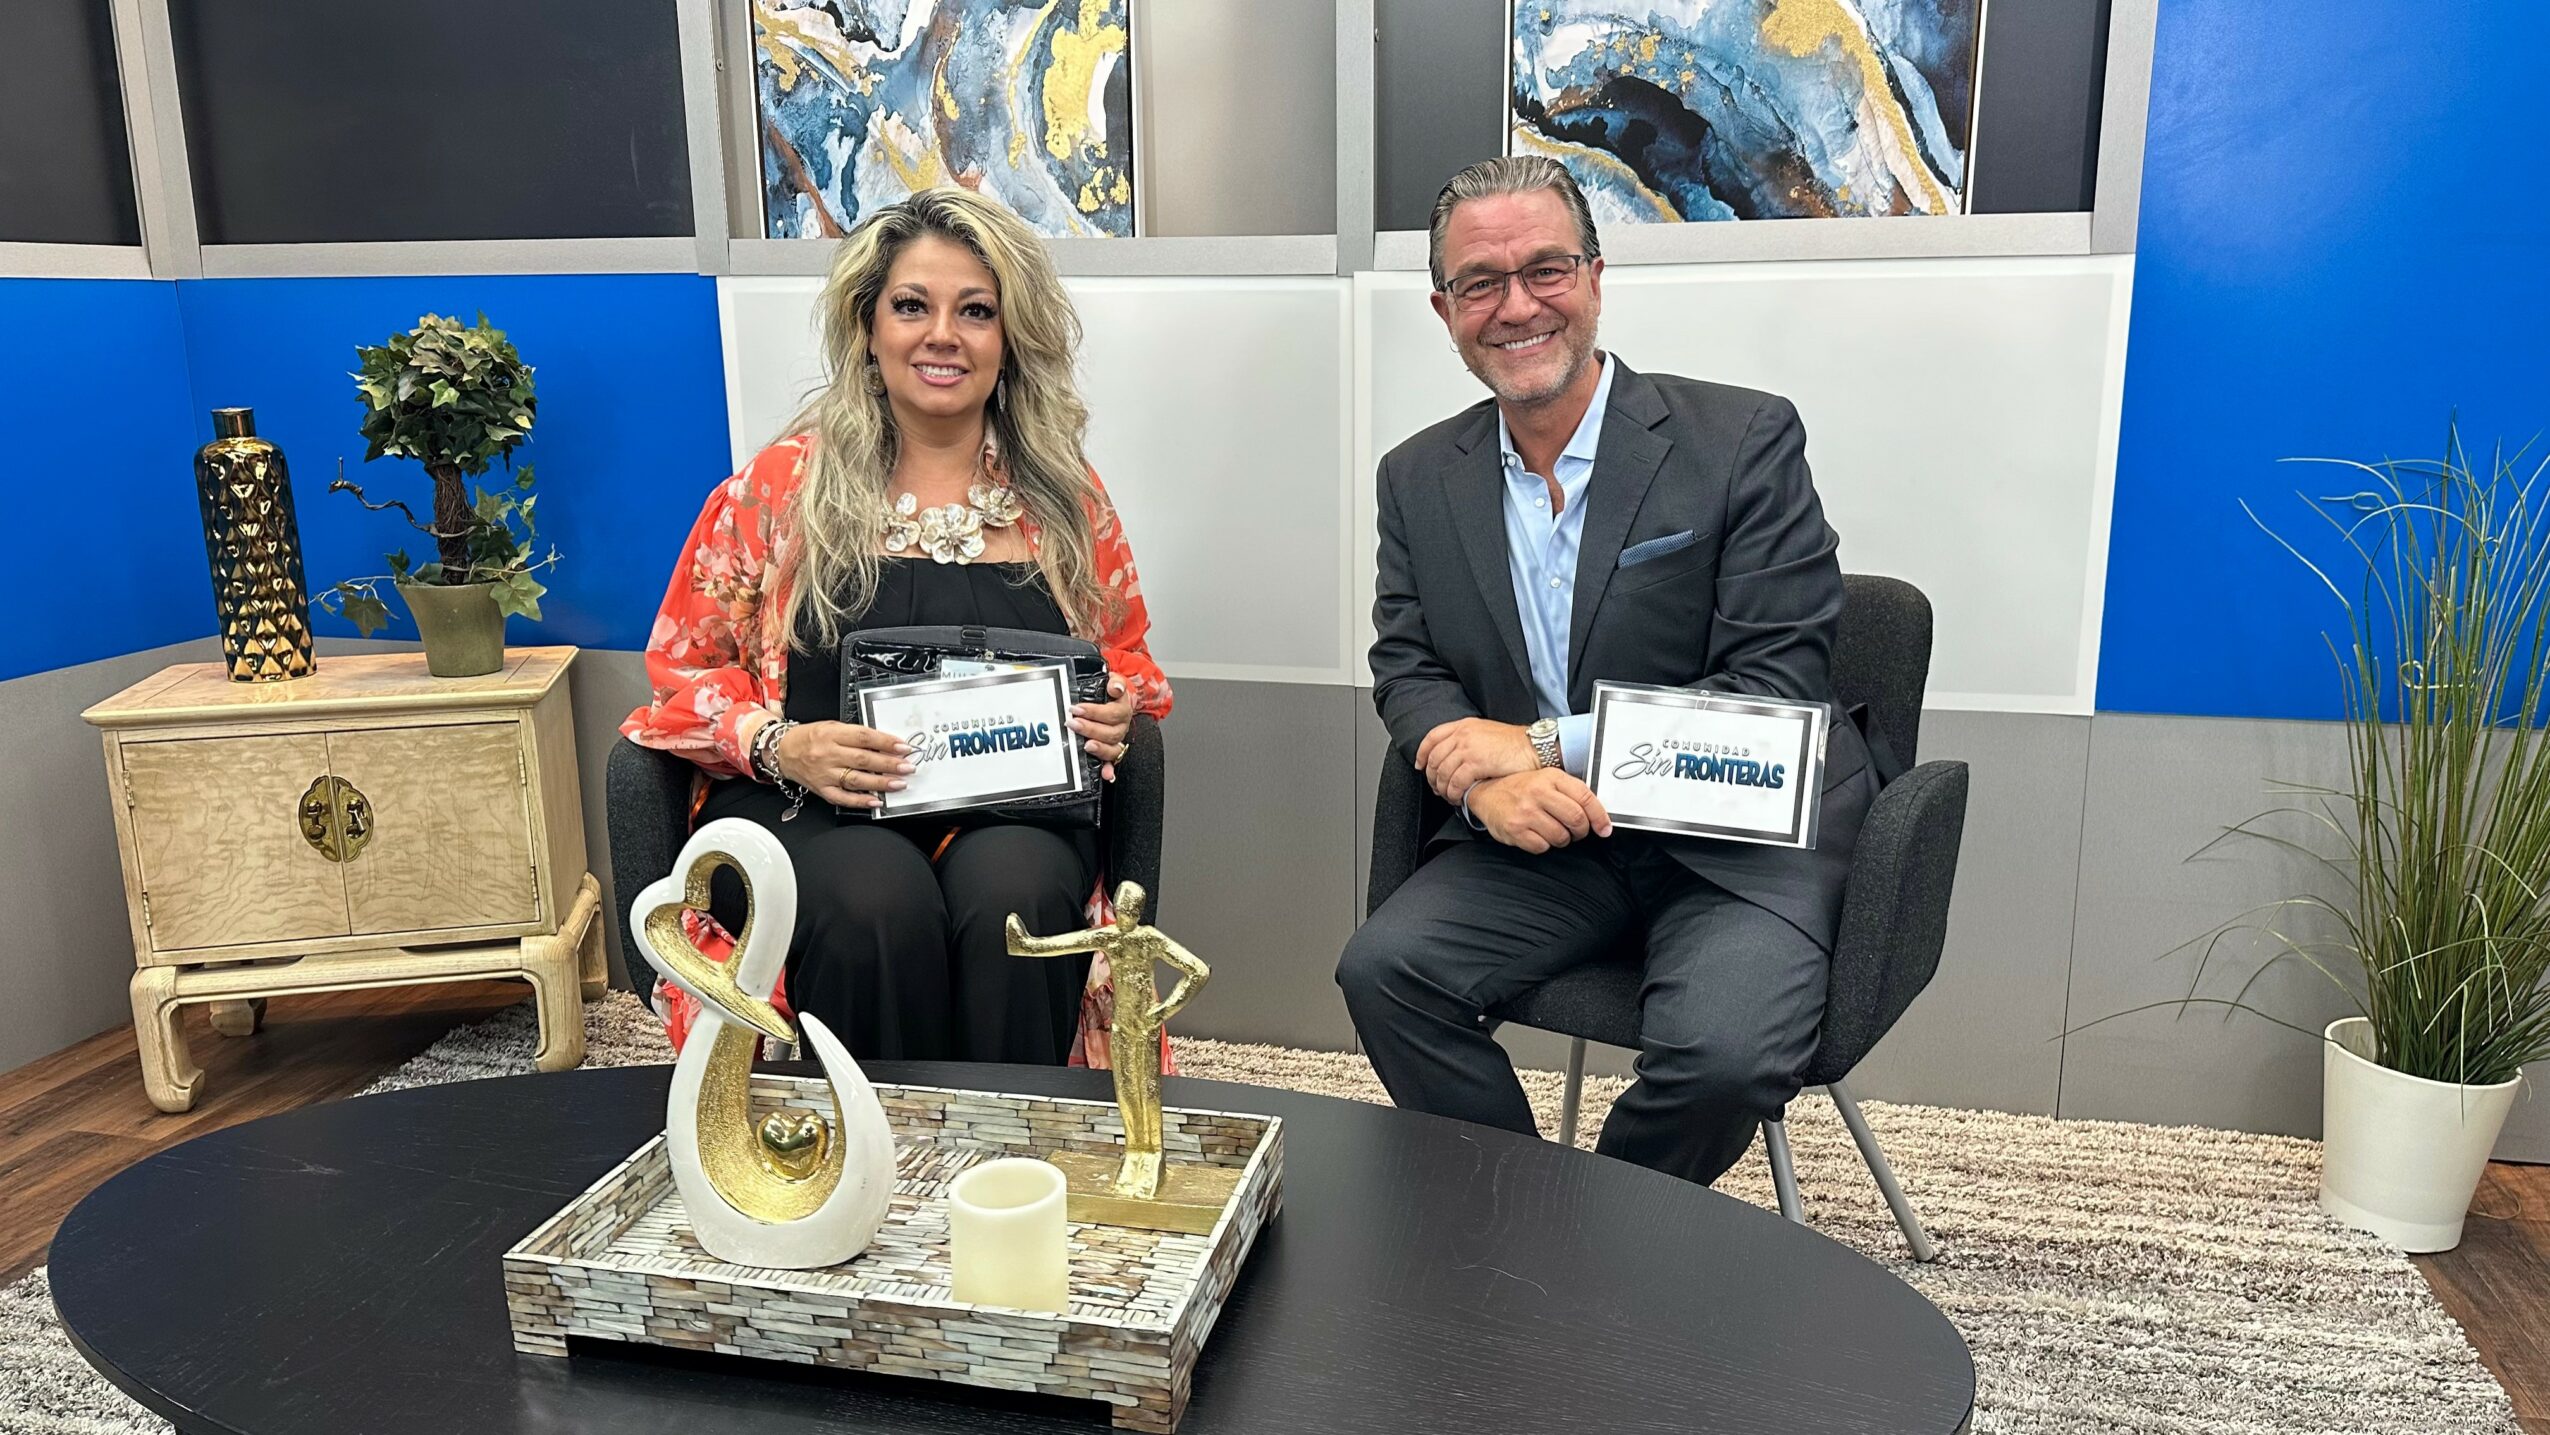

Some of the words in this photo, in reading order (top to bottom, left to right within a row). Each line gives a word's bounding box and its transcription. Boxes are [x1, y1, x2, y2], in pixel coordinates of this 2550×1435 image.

[933, 714, 1015, 734] COMUNIDAD
[903, 731, 949, 767] Sin
[948, 721, 1050, 758] FRONTERAS
[1662, 738, 1751, 757] COMUNIDAD
[1611, 741, 1673, 780] Sin
[1674, 752, 1785, 789] FRONTERAS
